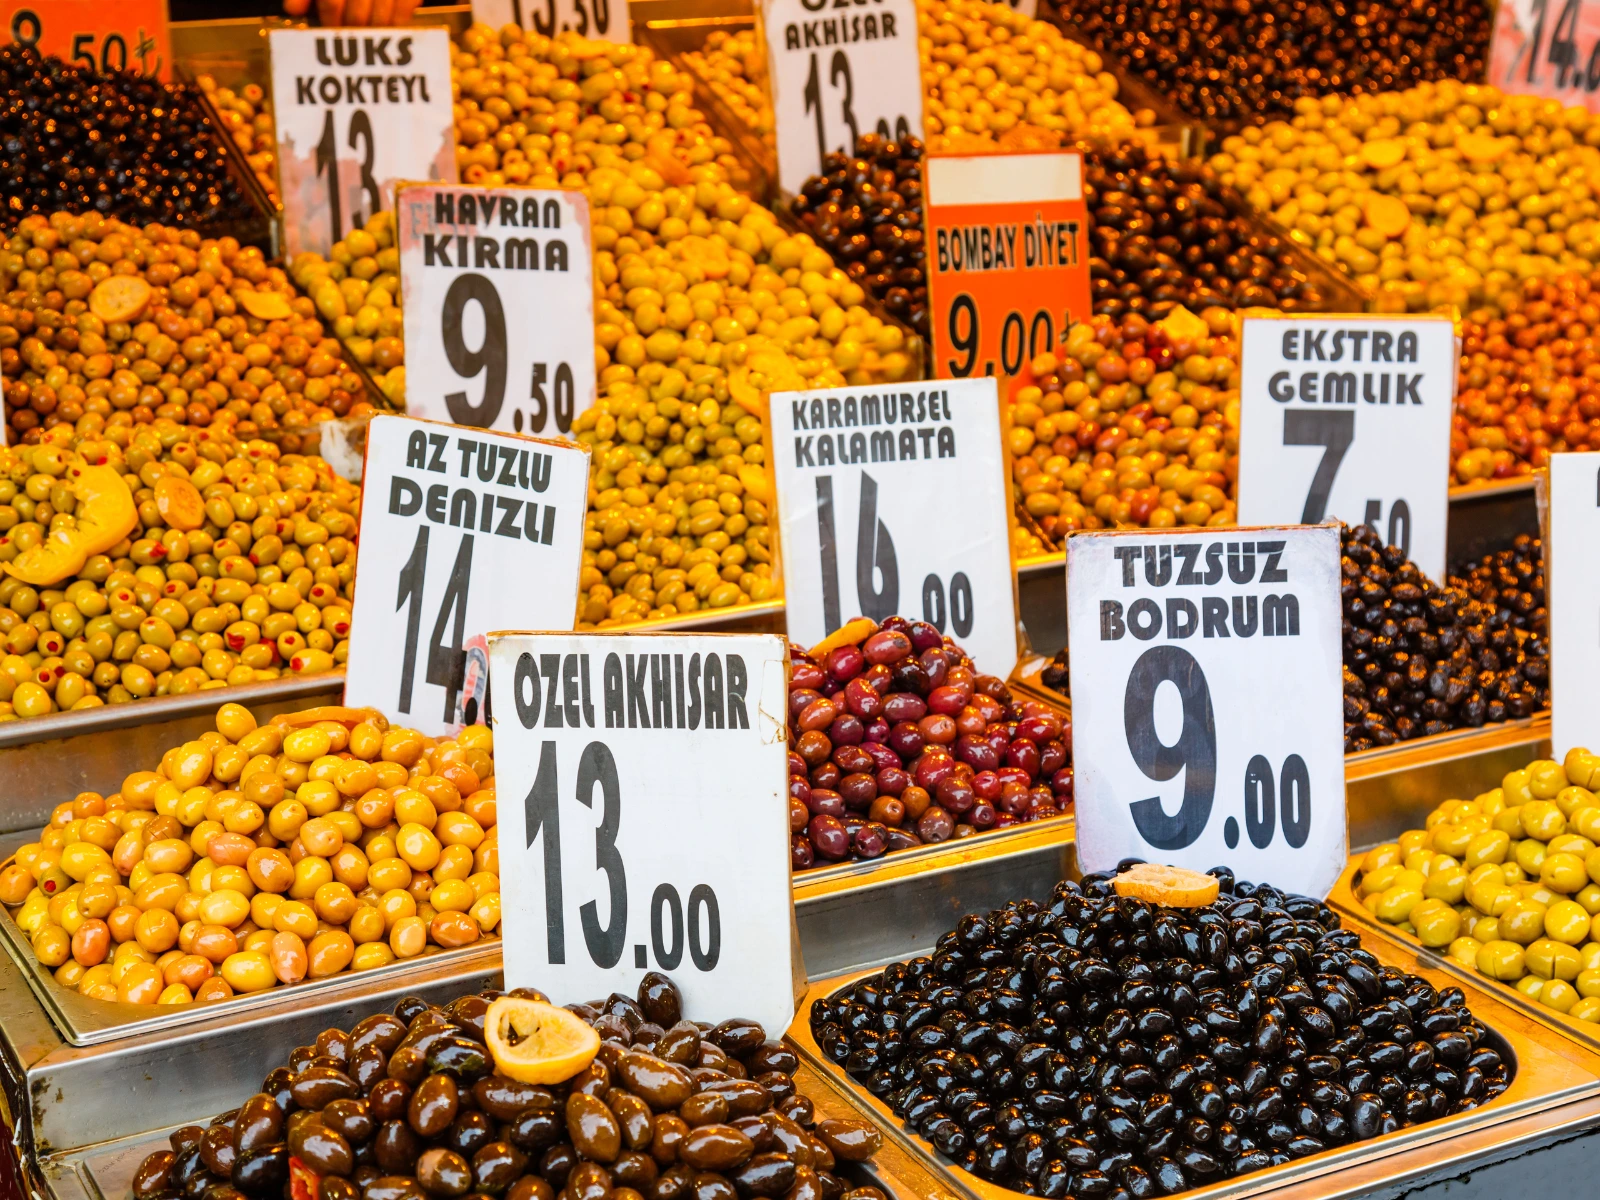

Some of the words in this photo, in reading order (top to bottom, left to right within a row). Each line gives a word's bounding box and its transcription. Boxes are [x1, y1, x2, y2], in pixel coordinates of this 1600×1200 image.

[297, 75, 430, 104] KOKTEYL
[435, 192, 561, 229] HAVRAN
[424, 234, 569, 271] KIRMA
[937, 225, 1016, 272] BOMBAY
[1024, 212, 1078, 267] DİYET
[1282, 329, 1418, 362] EKSTRA
[792, 390, 952, 430] KARAMURSEL
[1268, 371, 1425, 405] GEMLIK
[406, 429, 449, 473] AZ
[457, 438, 553, 493] TUZLU
[795, 426, 956, 467] KALAMATA
[388, 475, 557, 546] DENIZLI
[1113, 540, 1288, 587] TUZSUZ
[1100, 593, 1300, 641] BODRUM
[603, 651, 751, 731] AKHISAR
[1123, 645, 1312, 851] 9.00
[524, 740, 721, 972] 13.00
